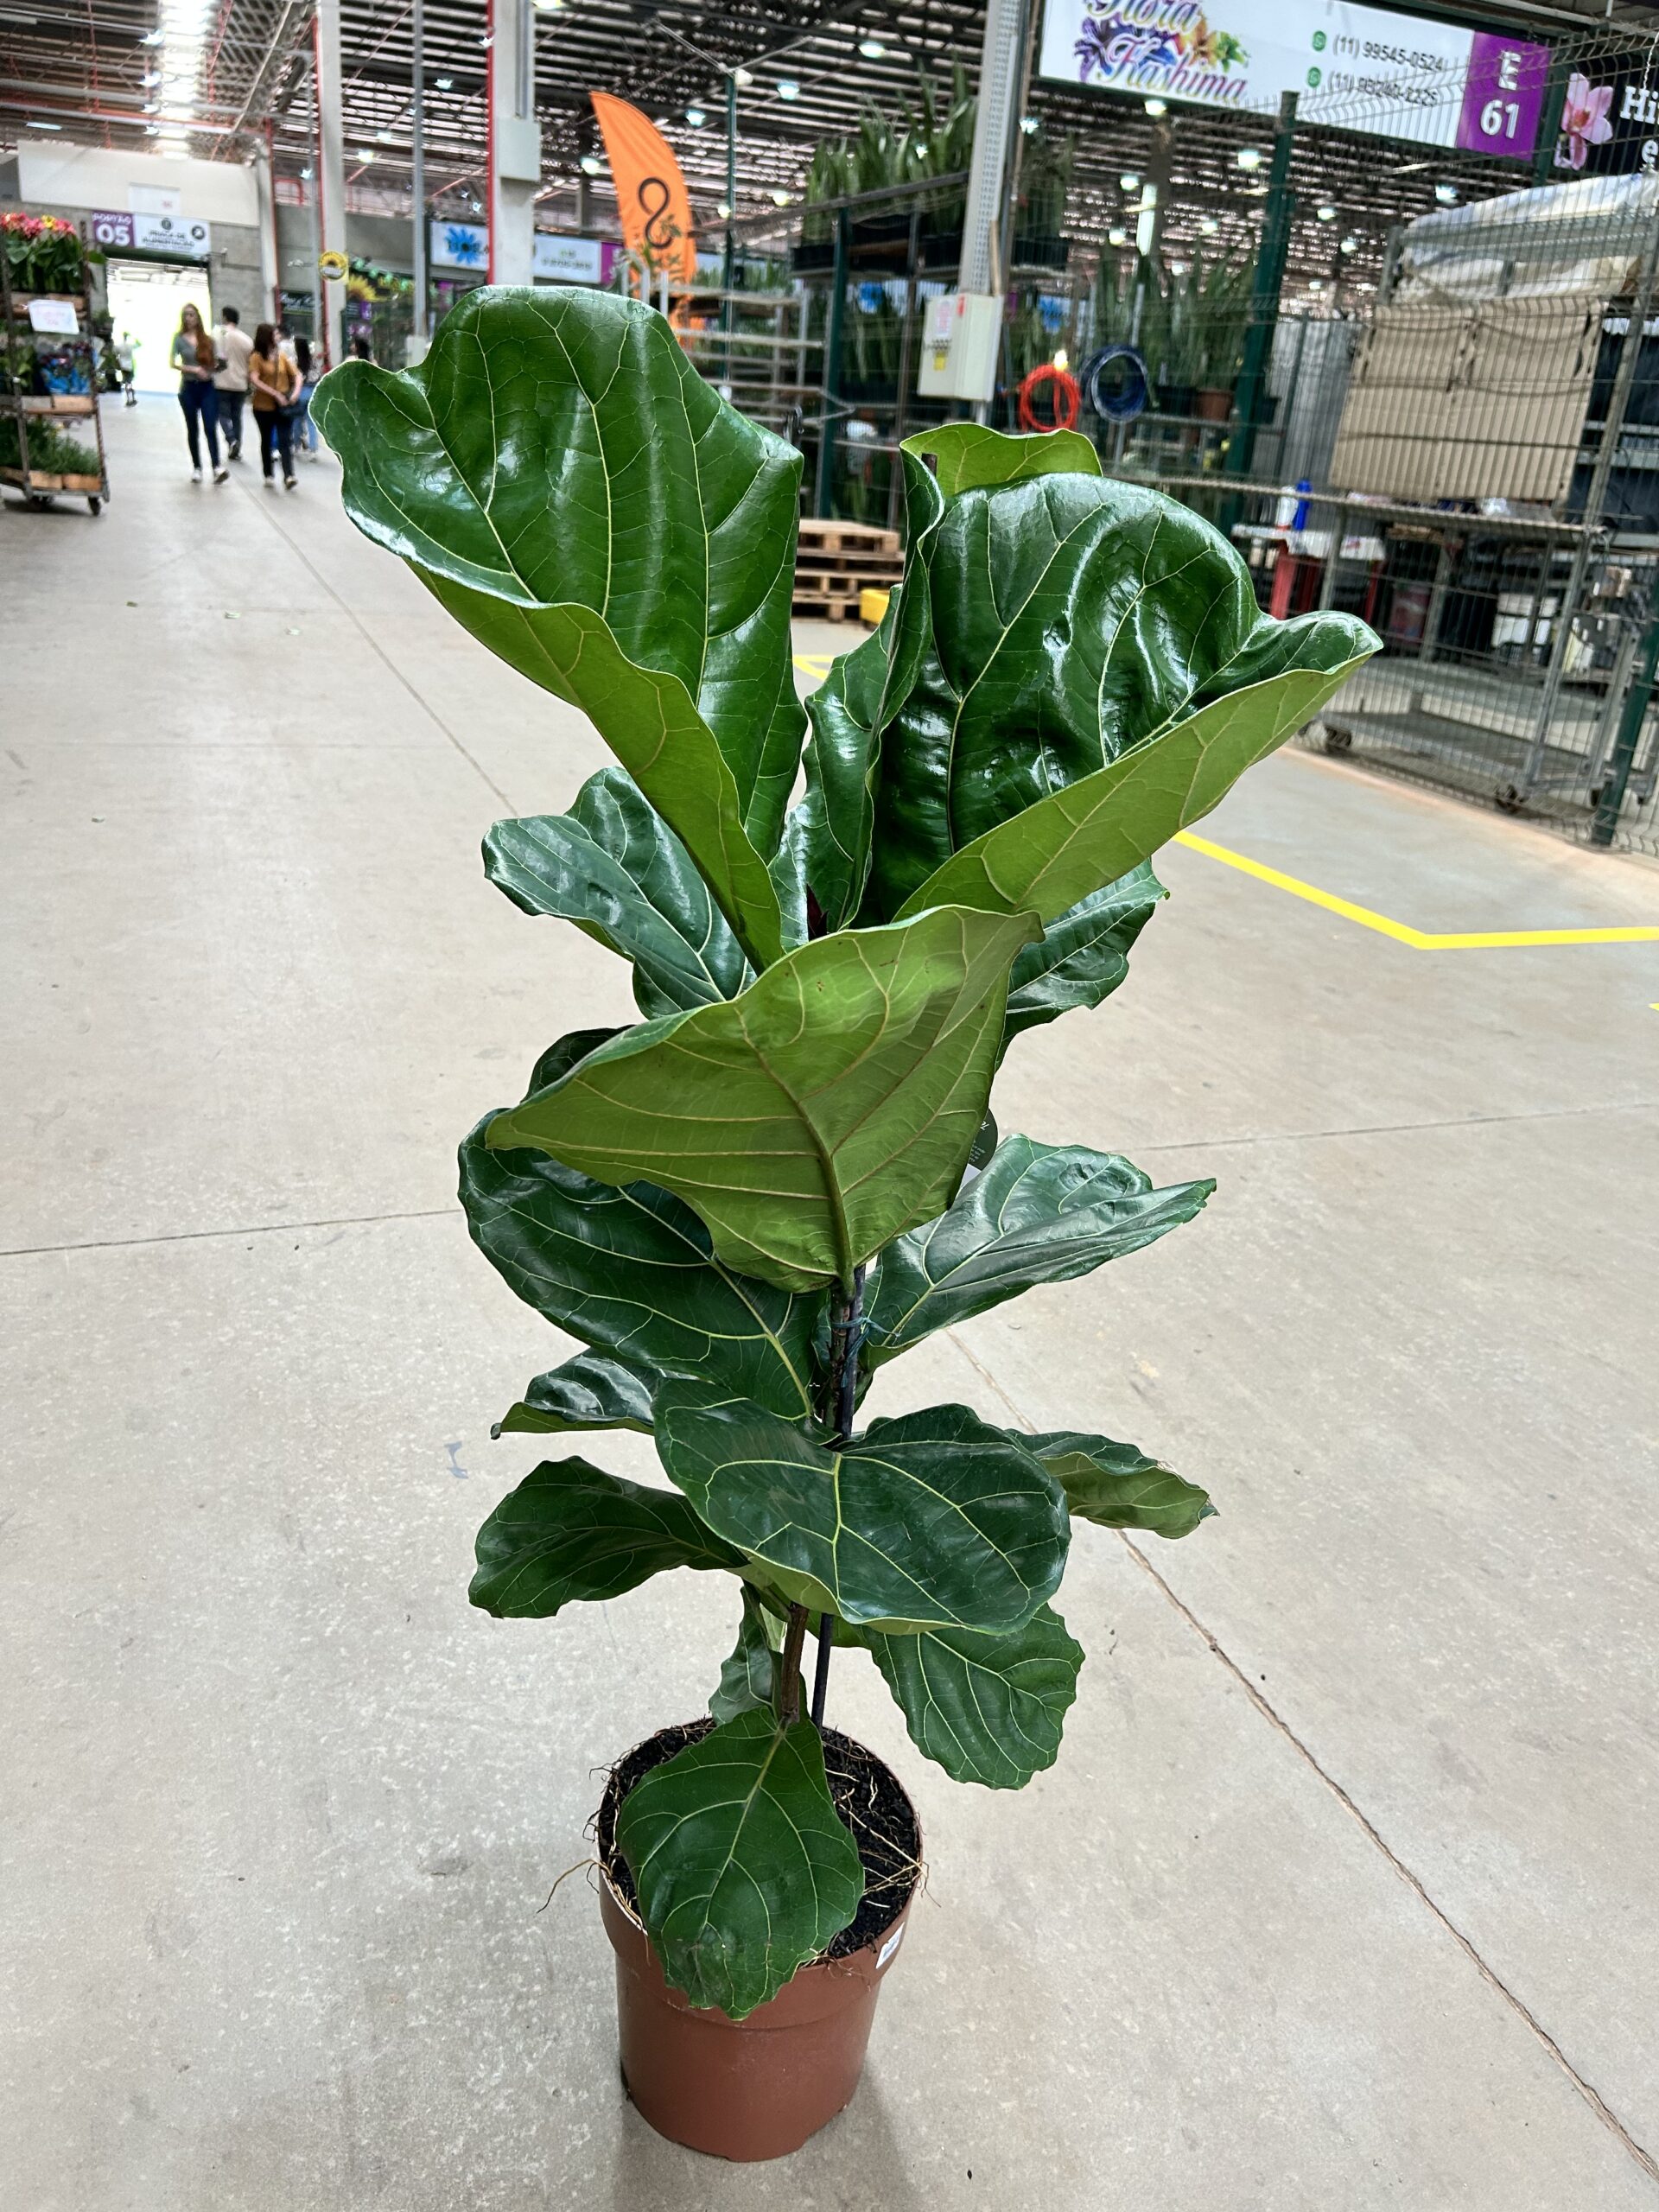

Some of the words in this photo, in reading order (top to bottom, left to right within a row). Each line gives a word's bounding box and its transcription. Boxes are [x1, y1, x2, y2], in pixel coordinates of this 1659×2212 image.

[1332, 35, 1360, 60] (11)
[1498, 49, 1522, 91] E
[1480, 99, 1520, 139] 61
[1619, 86, 1659, 124] Hi
[96, 223, 130, 246] 05
